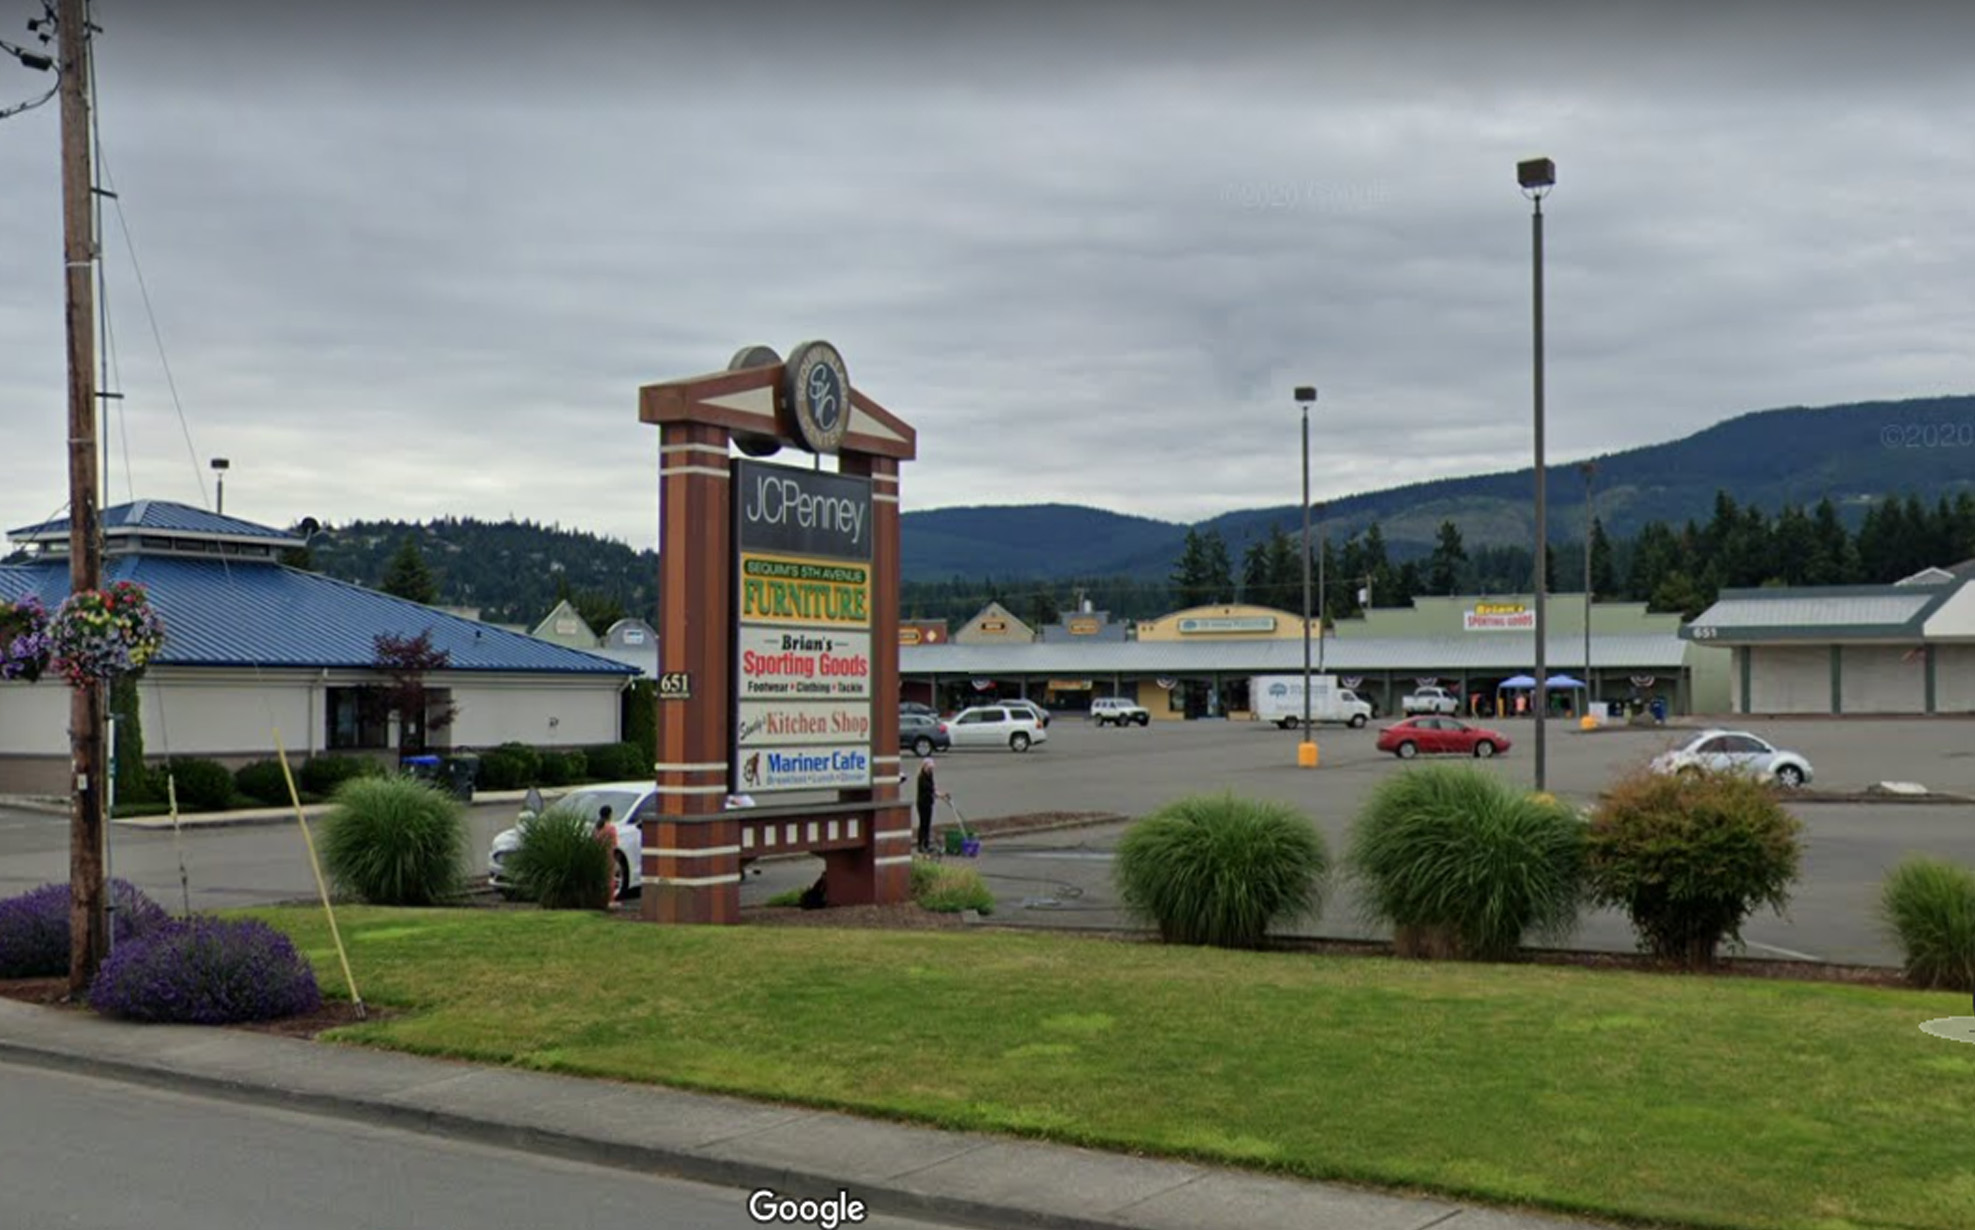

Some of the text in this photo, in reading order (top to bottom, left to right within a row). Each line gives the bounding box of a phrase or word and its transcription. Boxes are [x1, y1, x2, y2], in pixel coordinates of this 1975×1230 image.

[746, 475, 865, 544] JCPenney
[747, 561, 863, 583] SEQUIM'S 5TH AVENUE
[744, 577, 868, 621] FURNITURE
[781, 634, 833, 651] Brian's
[1693, 627, 1717, 639] 651
[743, 649, 868, 679] Sporting Goods
[661, 673, 689, 693] 651
[748, 680, 788, 693] Footwear
[796, 681, 831, 694] Clothing
[767, 711, 827, 735] Kitchen
[831, 709, 869, 738] Shop
[767, 750, 866, 774] Mariner Cafe
